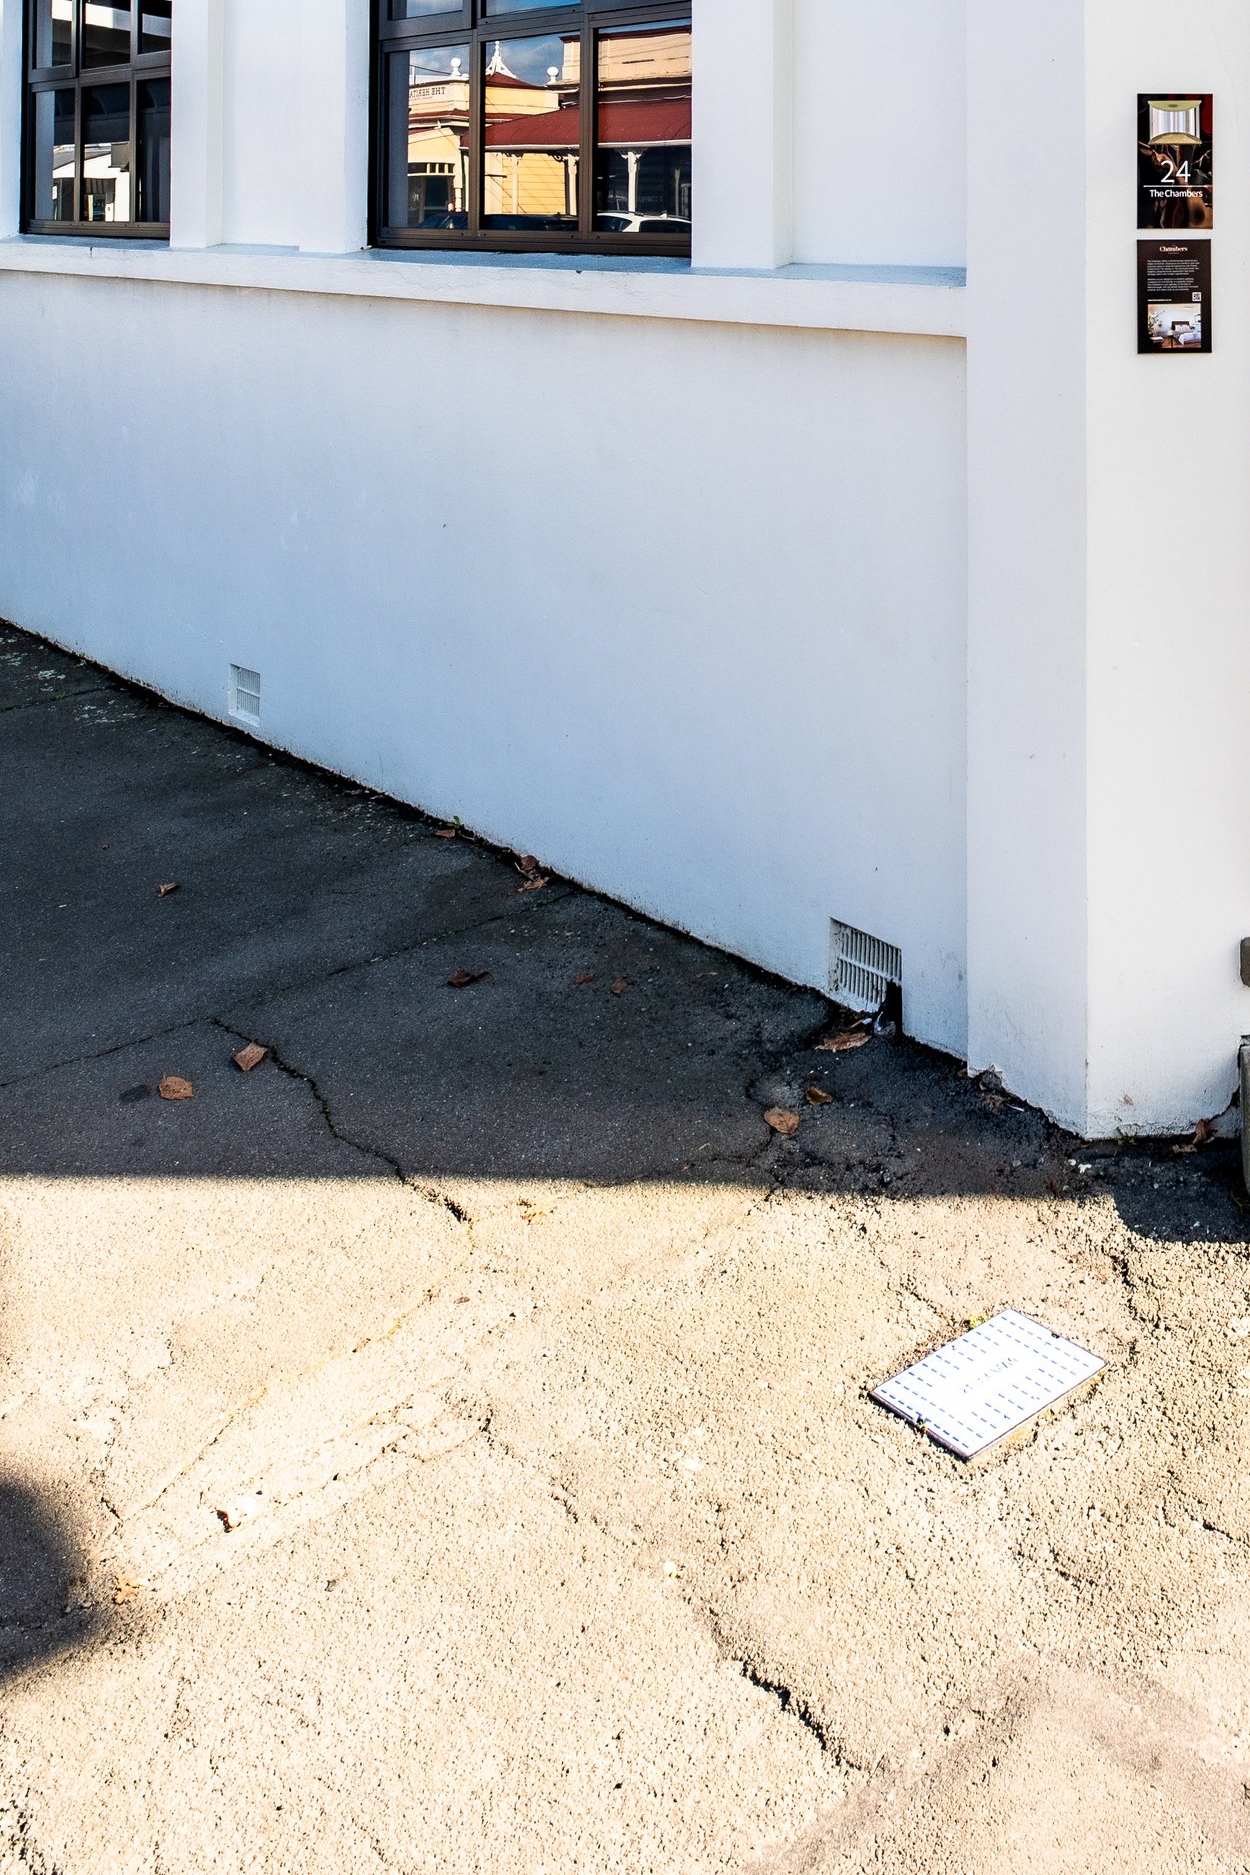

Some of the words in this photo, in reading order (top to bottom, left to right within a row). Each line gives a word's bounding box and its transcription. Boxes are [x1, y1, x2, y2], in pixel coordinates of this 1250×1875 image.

[1160, 160, 1191, 183] 24
[1149, 189, 1164, 198] The
[1164, 189, 1203, 198] Chambers
